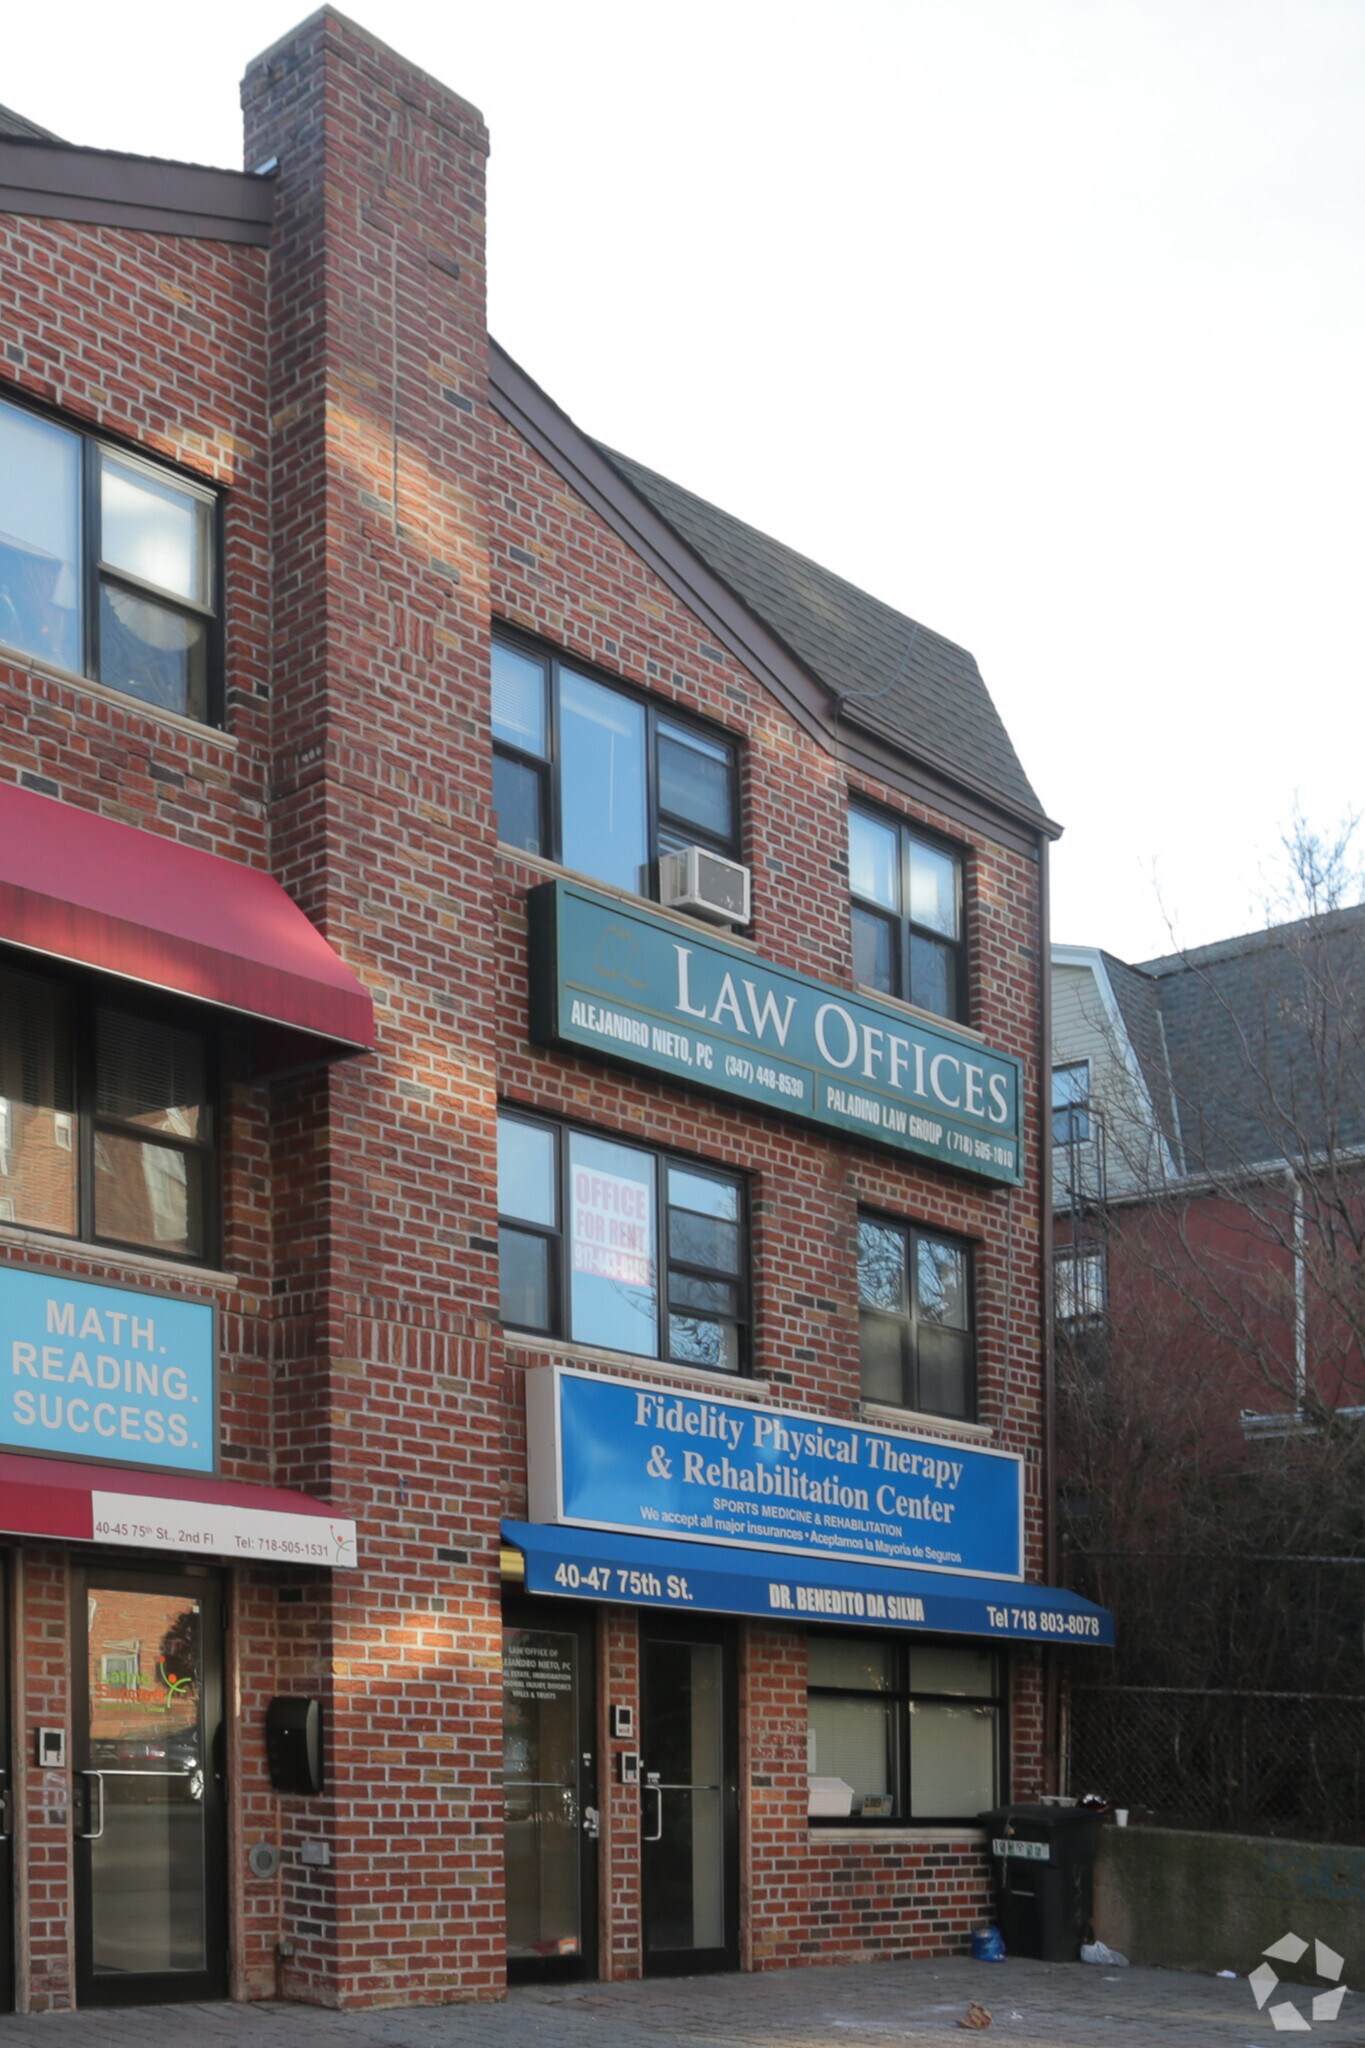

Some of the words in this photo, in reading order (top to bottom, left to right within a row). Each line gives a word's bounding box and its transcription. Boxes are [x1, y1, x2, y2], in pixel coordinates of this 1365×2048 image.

[571, 1000, 649, 1048] ALEJANDRO
[652, 1026, 692, 1066] NIETO,
[696, 1042, 713, 1069] PC
[725, 1055, 753, 1084] (347)
[756, 1066, 803, 1098] 448-8530
[673, 944, 797, 1047] LAW
[814, 1002, 1007, 1123] OFFICES
[827, 1086, 880, 1125] PALADINO
[882, 1105, 907, 1134] LAW
[909, 1114, 942, 1146] GROUP
[576, 1172, 646, 1221] OFFICE
[576, 1208, 605, 1243] FOR
[609, 1217, 646, 1253] RENT
[46, 1298, 167, 1354] MATH.
[11, 1340, 199, 1404] READING.
[12, 1390, 199, 1449] SUCCESS.
[634, 1392, 744, 1450] Fidelity
[752, 1415, 858, 1465] Physical
[866, 1437, 963, 1490] Therapy
[646, 1444, 673, 1480] &
[682, 1450, 870, 1511] Rehabilitation
[876, 1484, 955, 1524] Center
[96, 1521, 128, 1536] 40-45
[132, 1524, 153, 1538] 75th
[156, 1526, 175, 1542] St.,
[178, 1529, 200, 1544] 2nd
[640, 1505, 659, 1521] We
[661, 1512, 699, 1529] accept
[700, 1514, 713, 1528] all
[715, 1518, 746, 1534] major
[747, 1520, 803, 1541] insurances
[810, 1530, 864, 1548] Aceptamos
[865, 1537, 874, 1551] la
[912, 1545, 923, 1557] de
[925, 1546, 962, 1563] Seguros
[713, 1497, 759, 1516] SPORTS
[762, 1504, 812, 1524] MEDICINE
[814, 1514, 822, 1526] &
[823, 1514, 903, 1537] REHABILITATION
[235, 1535, 255, 1549] Tel:
[258, 1538, 329, 1557] 718-505-1531
[554, 1562, 611, 1591] 40-47
[616, 1569, 662, 1597] 75th
[666, 1575, 694, 1600] St.
[769, 1583, 796, 1611] DR.
[797, 1586, 864, 1617] BENEDITO
[866, 1592, 887, 1618] DA
[888, 1596, 925, 1622] SILVA
[986, 1605, 1009, 1628] Tel
[1011, 1608, 1037, 1631] 718
[1040, 1612, 1100, 1636] 803-8078
[509, 1646, 524, 1655] LAW
[525, 1647, 548, 1657] OFFICE
[562, 1662, 571, 1670] PC
